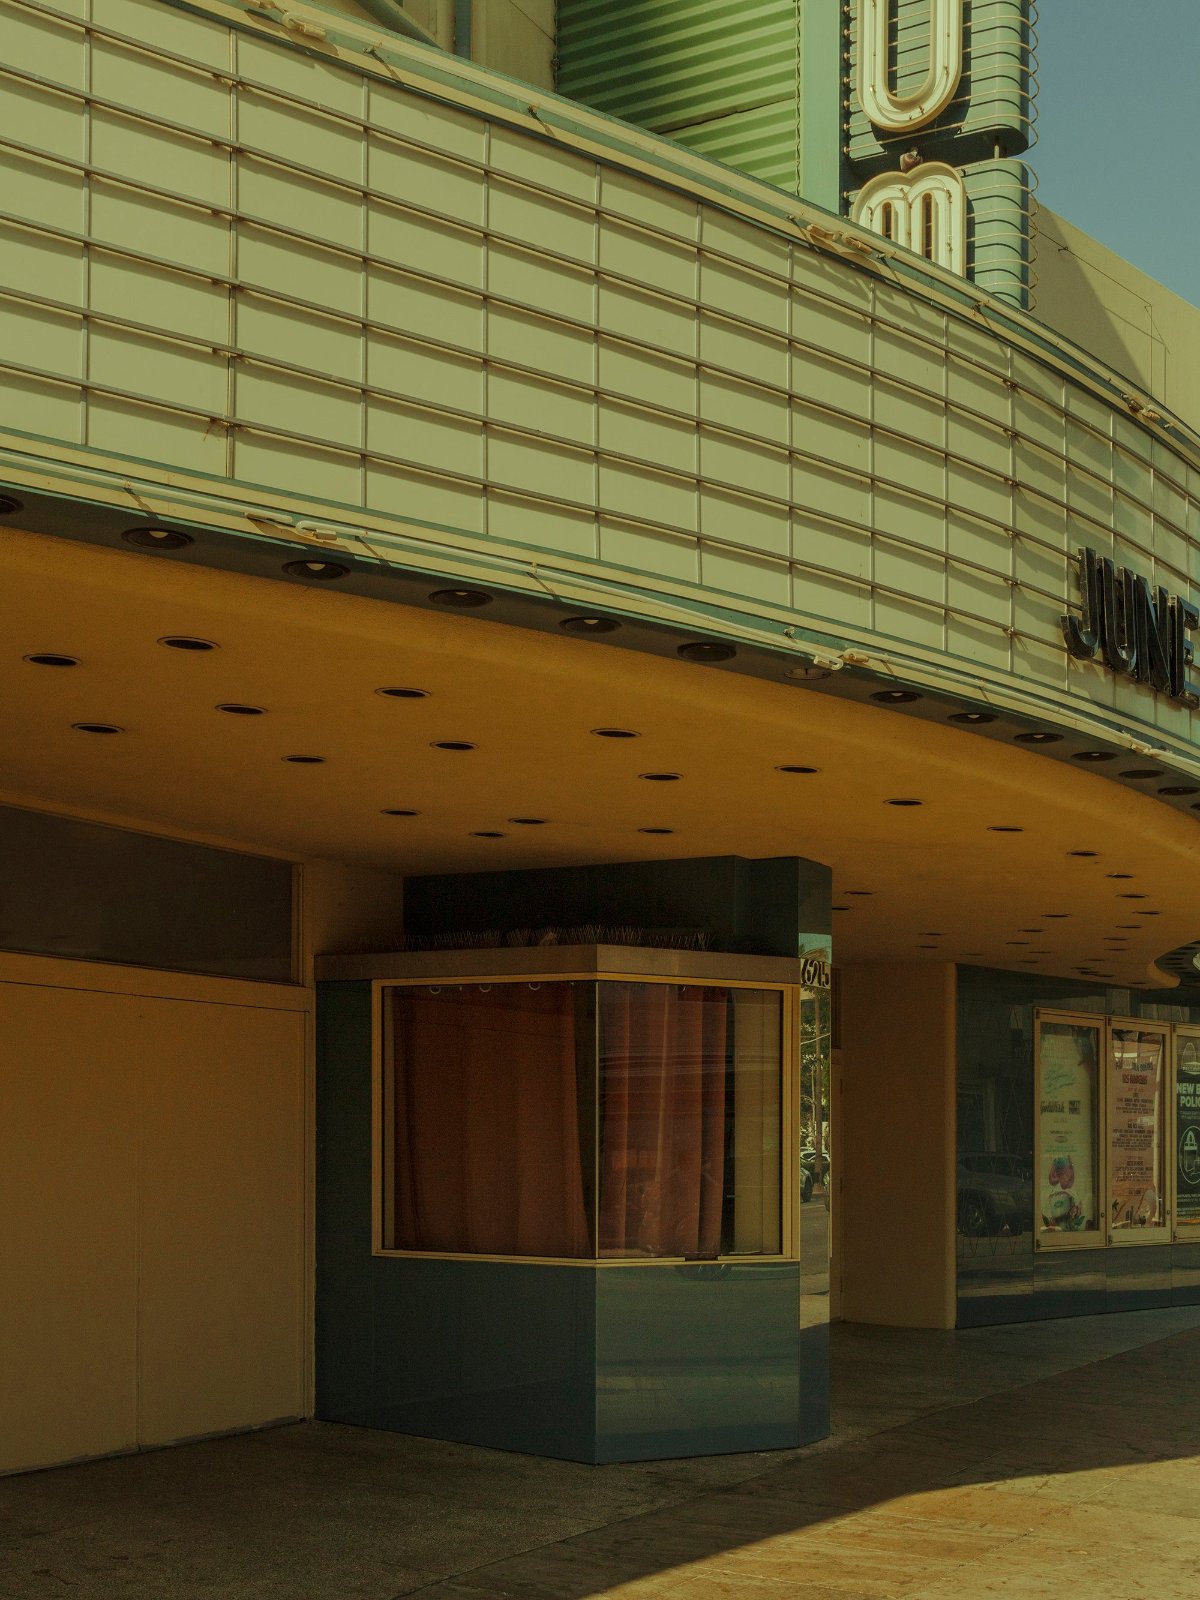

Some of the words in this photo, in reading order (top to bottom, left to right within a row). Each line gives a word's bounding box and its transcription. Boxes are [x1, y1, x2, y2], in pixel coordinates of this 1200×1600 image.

[1060, 547, 1200, 709] JUNE
[801, 958, 830, 988] 6215
[1176, 1083, 1195, 1095] NEW
